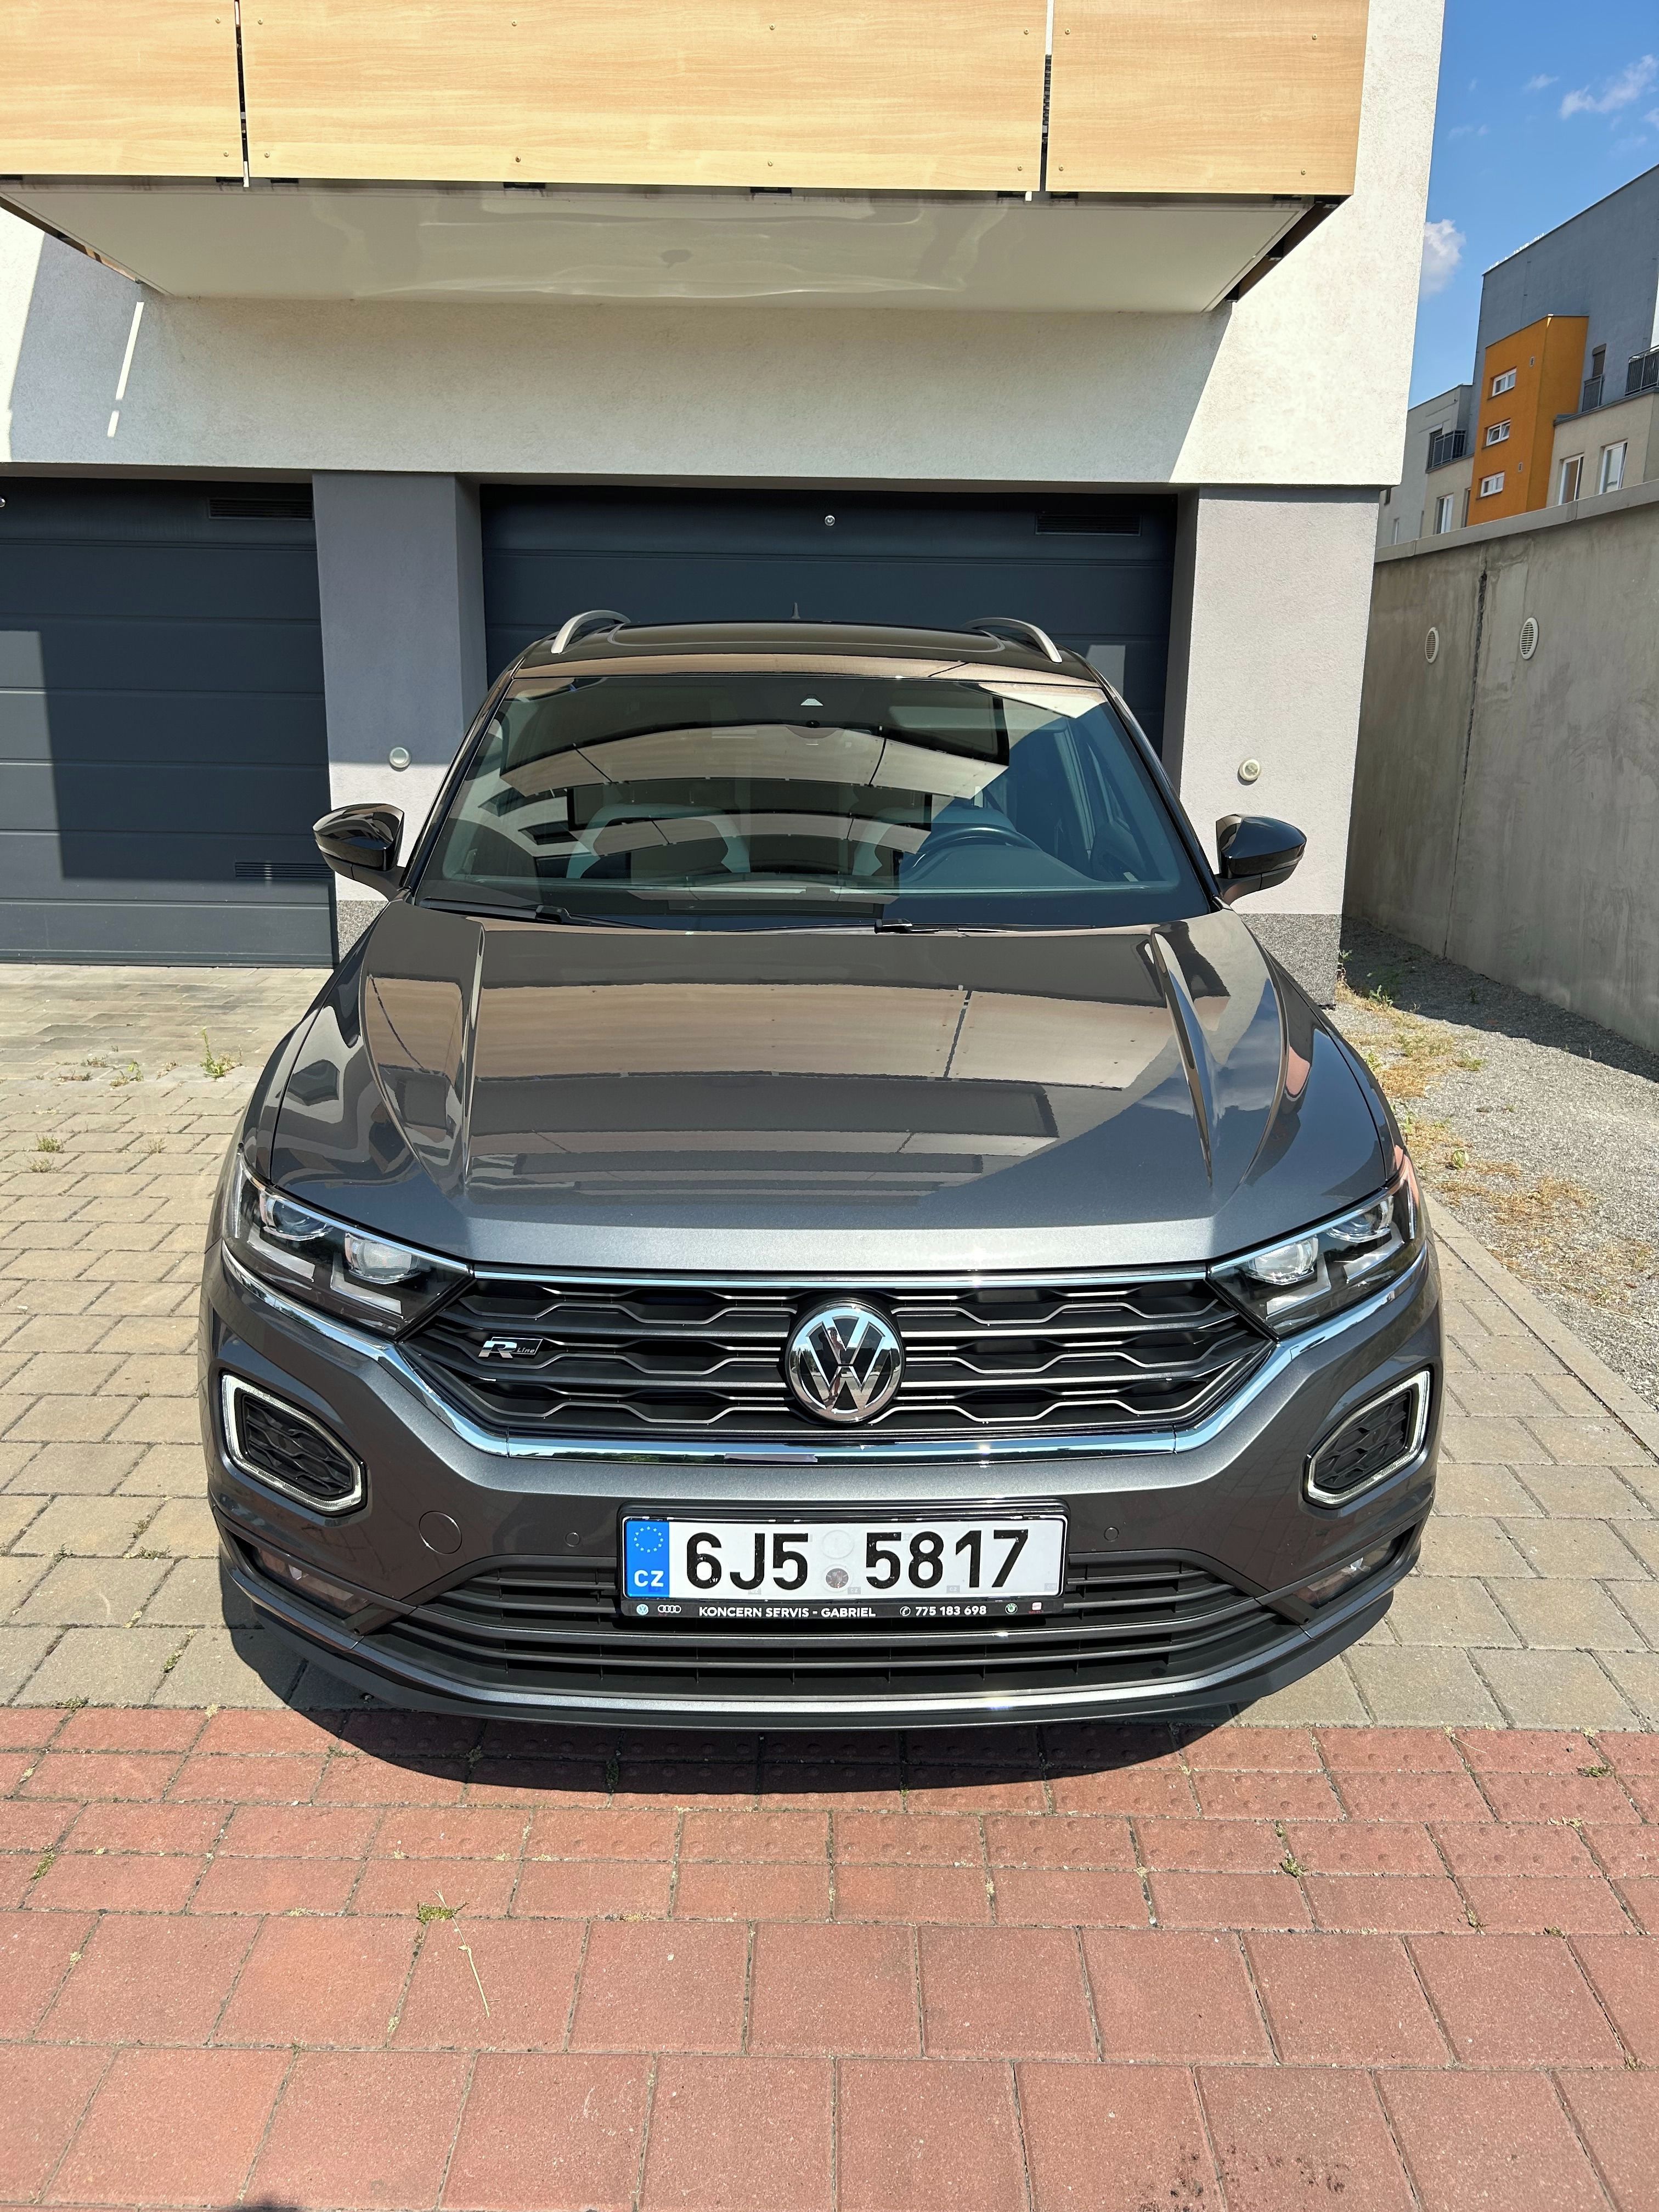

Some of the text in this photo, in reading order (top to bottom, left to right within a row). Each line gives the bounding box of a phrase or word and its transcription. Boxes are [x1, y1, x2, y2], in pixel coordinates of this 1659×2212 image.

[478, 1340, 517, 1358] R
[686, 1529, 1029, 1590] 6J5 5817
[634, 1570, 664, 1587] CZ
[699, 1606, 762, 1617] KONCERN
[765, 1607, 809, 1618] SERVIS
[821, 1607, 876, 1618] GABRIEL
[915, 1606, 936, 1616] 775
[939, 1605, 961, 1616] 183
[964, 1605, 987, 1616] 698
